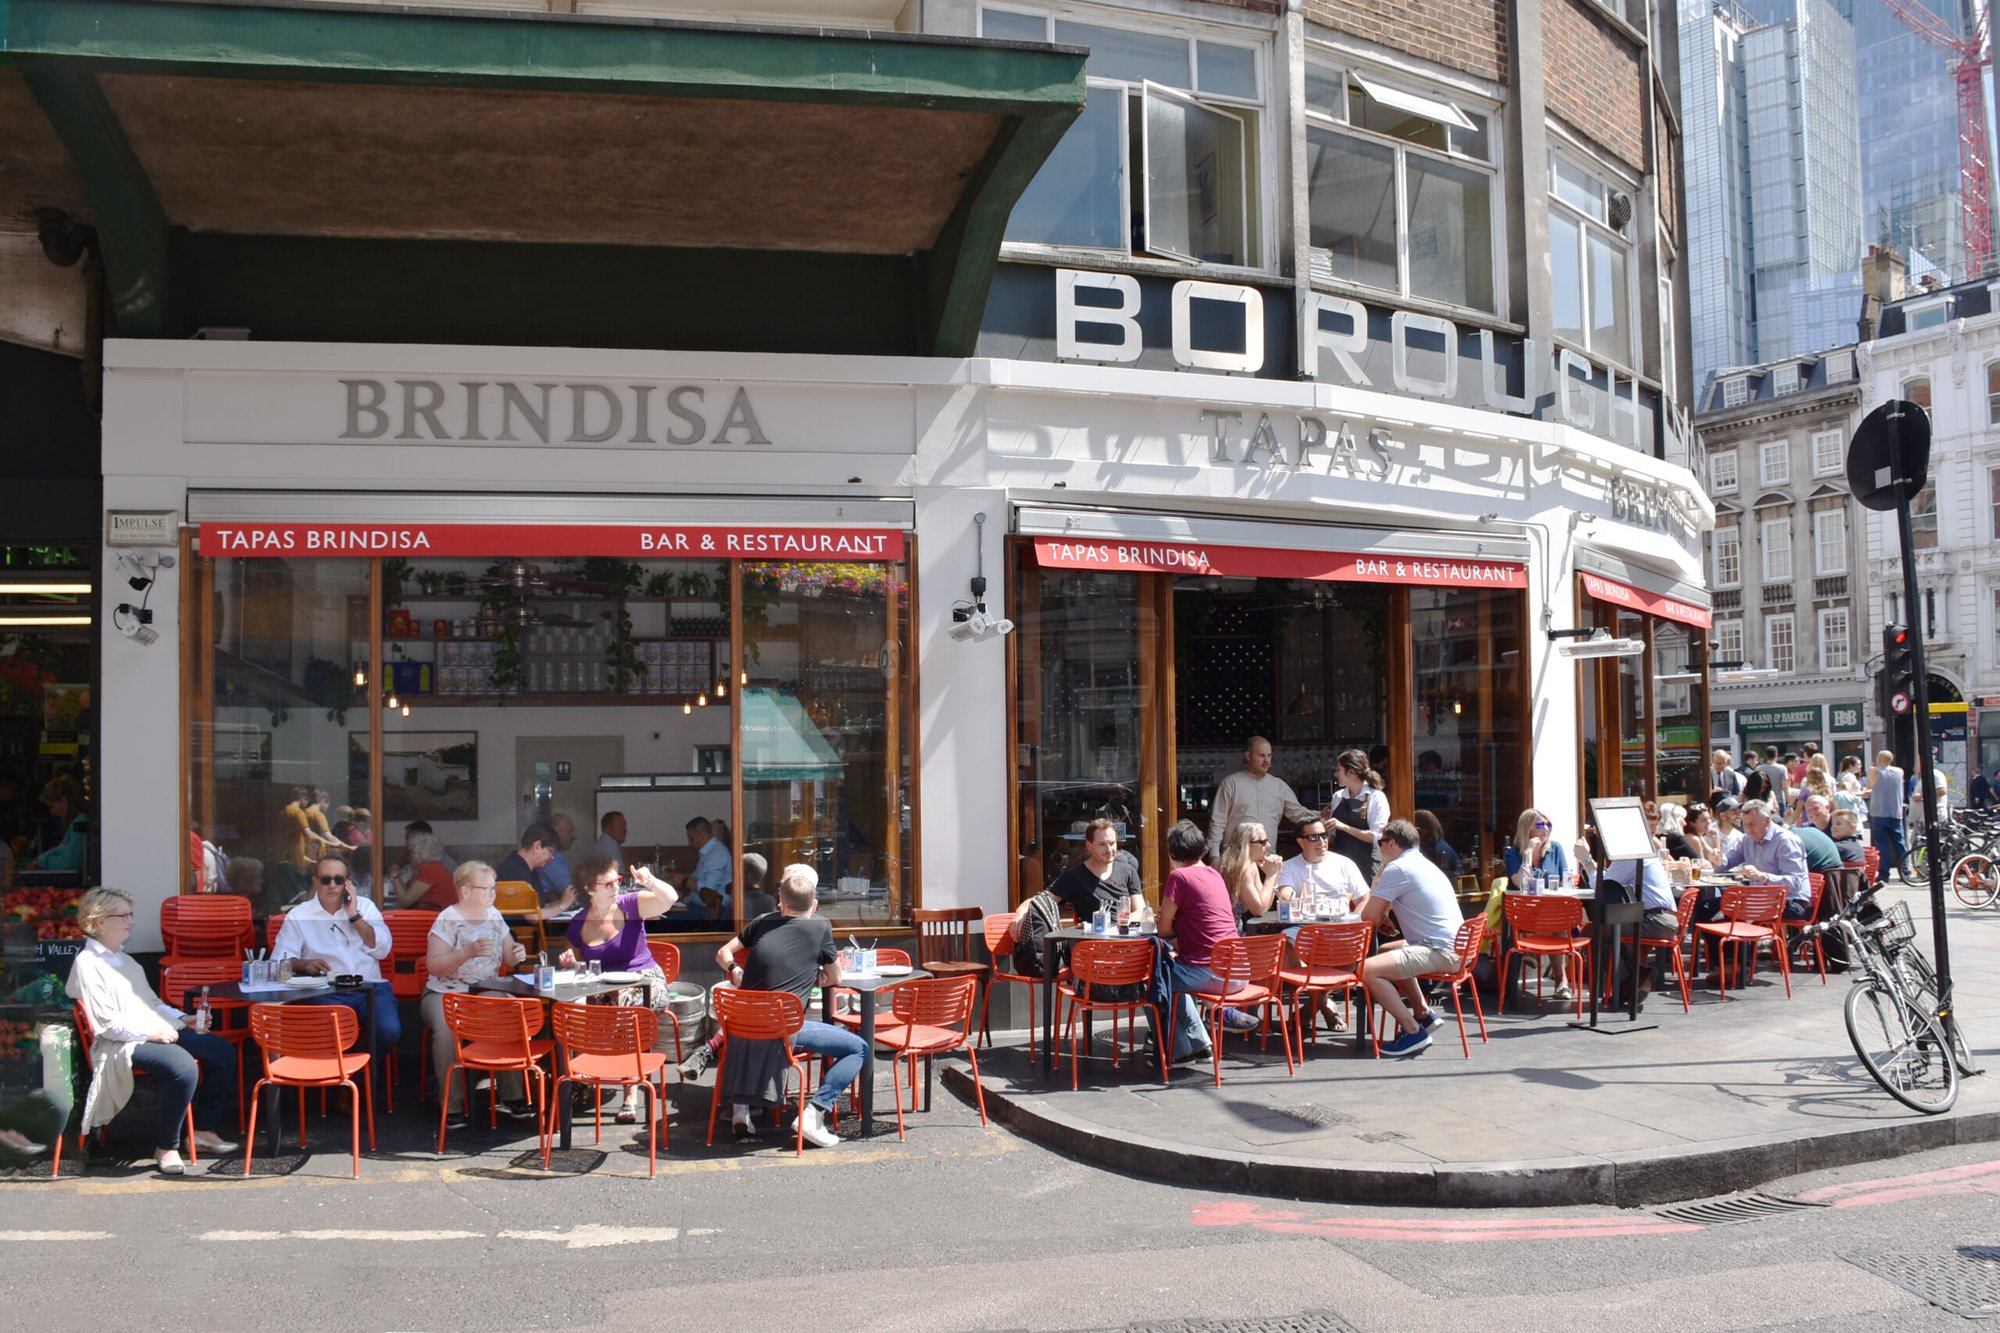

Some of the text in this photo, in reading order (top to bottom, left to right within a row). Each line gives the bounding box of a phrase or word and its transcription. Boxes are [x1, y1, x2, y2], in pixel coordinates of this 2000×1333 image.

[1055, 268, 1641, 448] BOROUGH
[337, 379, 773, 446] BRINDISA
[1201, 408, 1394, 477] TAPAS
[113, 516, 167, 530] IMPULSE
[216, 530, 431, 550] TAPAS BRINDISA
[640, 532, 888, 554] BAR & RESTAURANT
[1047, 542, 1211, 568] TAPAS BRINDISA
[1355, 558, 1515, 583] BAR & RESTAURANT
